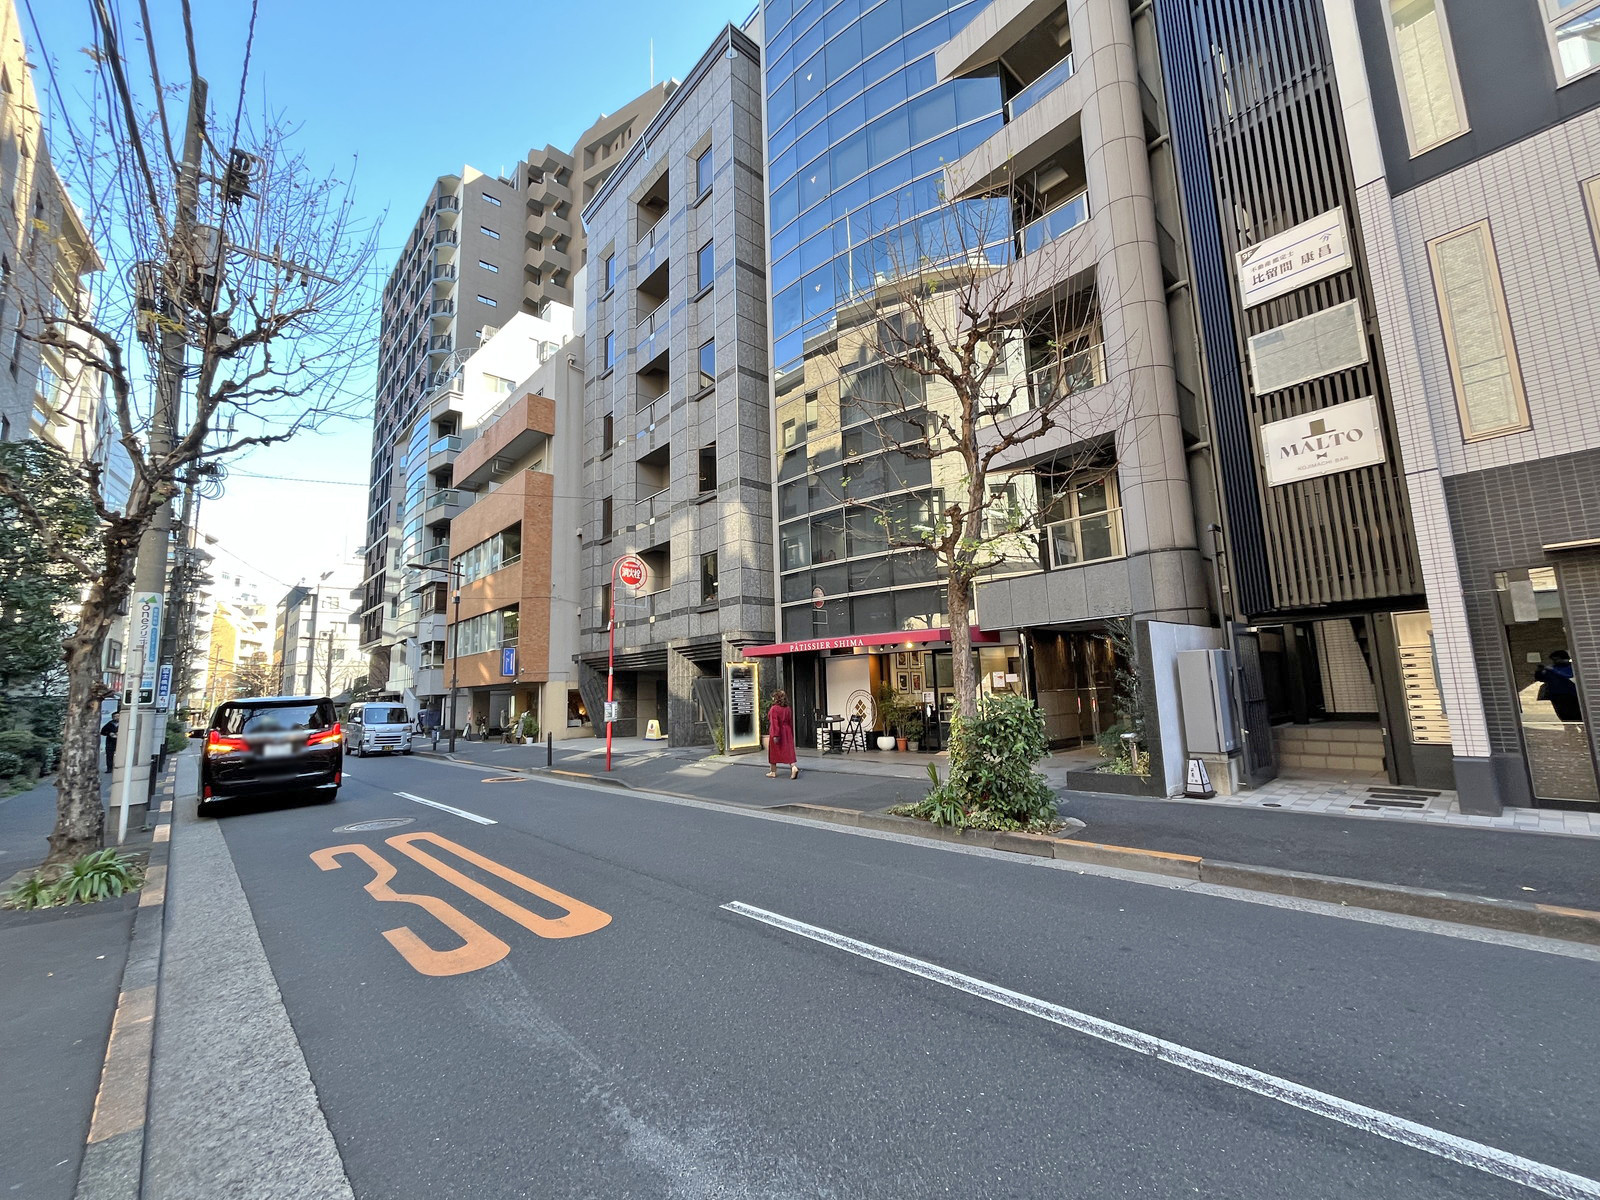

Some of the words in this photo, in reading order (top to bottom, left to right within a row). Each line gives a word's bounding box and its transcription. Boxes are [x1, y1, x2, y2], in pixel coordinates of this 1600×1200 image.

[1241, 251, 1253, 260] 9F
[1252, 260, 1293, 285] 比留間
[1280, 428, 1363, 459] MALTO
[1297, 460, 1332, 471] KOJIMACHI
[1335, 455, 1349, 463] BAR
[789, 641, 831, 652] PÂTISSIER
[834, 638, 864, 648] SHIMA
[309, 832, 613, 976] 30
